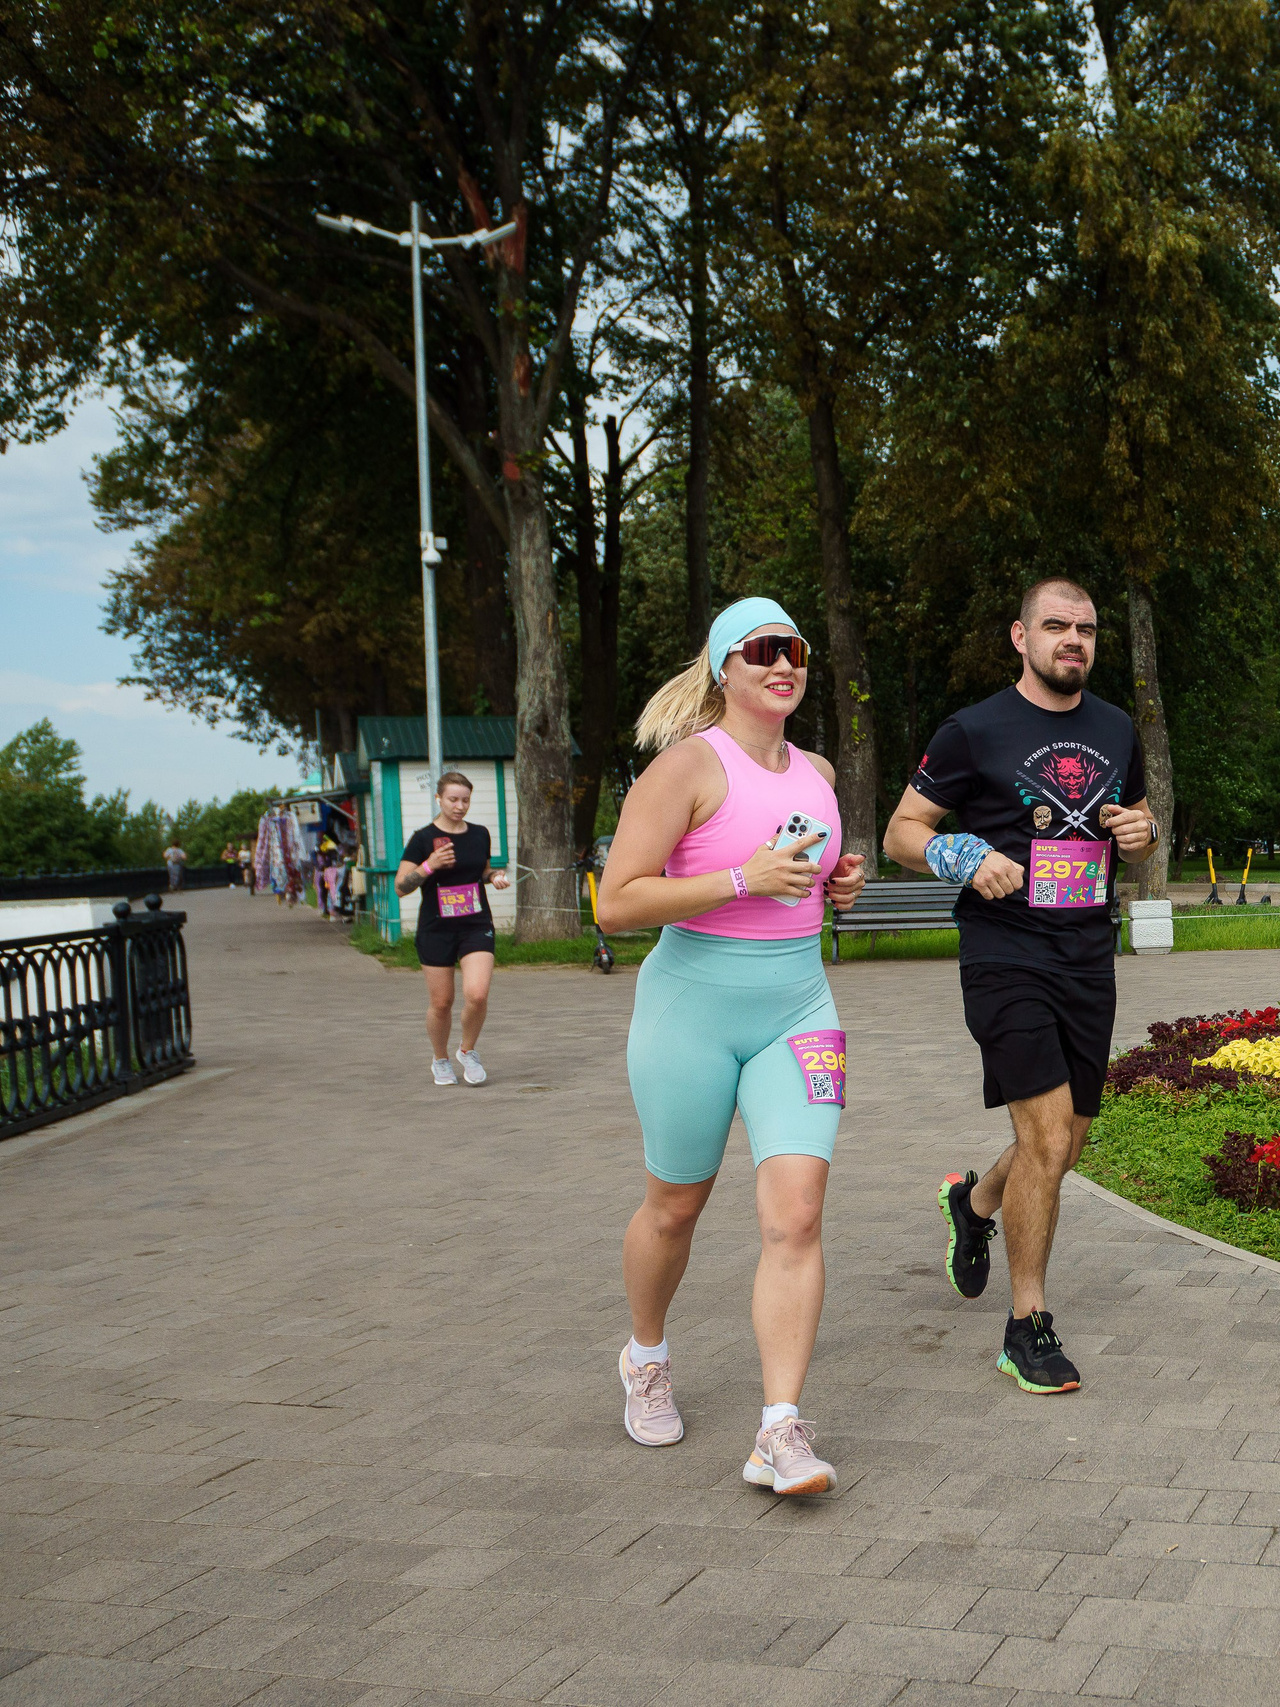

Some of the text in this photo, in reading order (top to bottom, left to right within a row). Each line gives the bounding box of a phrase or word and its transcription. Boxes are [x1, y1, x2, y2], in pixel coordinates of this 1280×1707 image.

[1023, 741, 1110, 768] STREIN SPORTSWEAR
[1034, 859, 1096, 879] 297 2
[441, 894, 466, 905] 153
[794, 1036, 820, 1046] RUTS
[802, 1050, 846, 1074] 296
